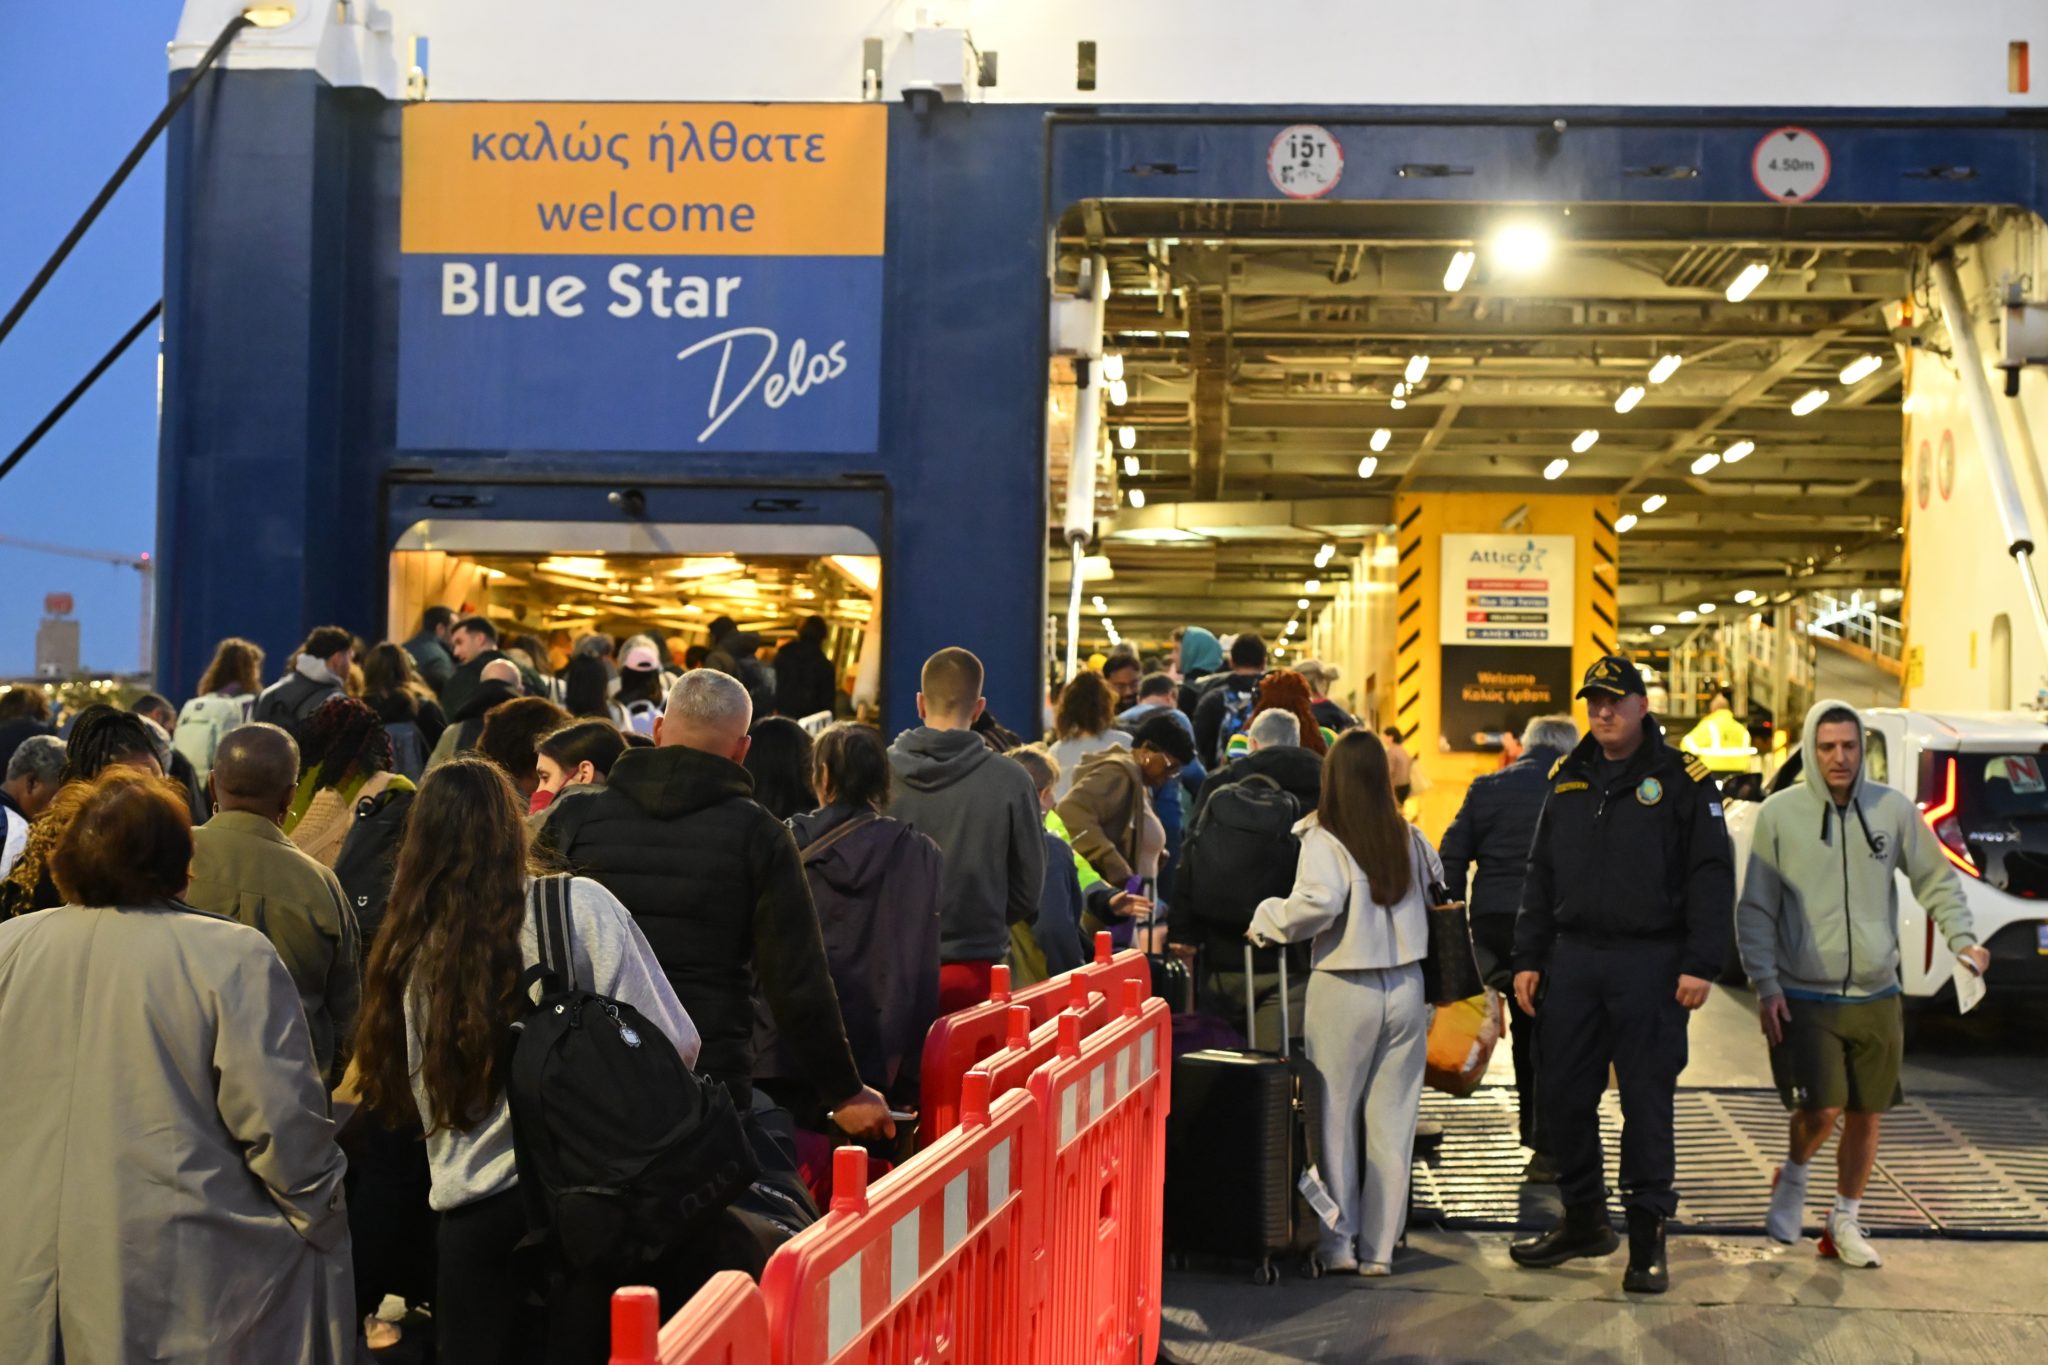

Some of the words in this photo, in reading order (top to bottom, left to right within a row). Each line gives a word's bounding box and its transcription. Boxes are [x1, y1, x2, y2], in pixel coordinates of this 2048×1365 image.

[471, 120, 630, 169] καλώς
[648, 121, 826, 173] ήλθατε
[1768, 158, 1815, 171] 4.50m
[537, 191, 756, 233] welcome
[441, 262, 588, 318] Blue
[607, 262, 742, 319] Star
[676, 326, 849, 443] Delos
[1477, 671, 1536, 686] Welcome
